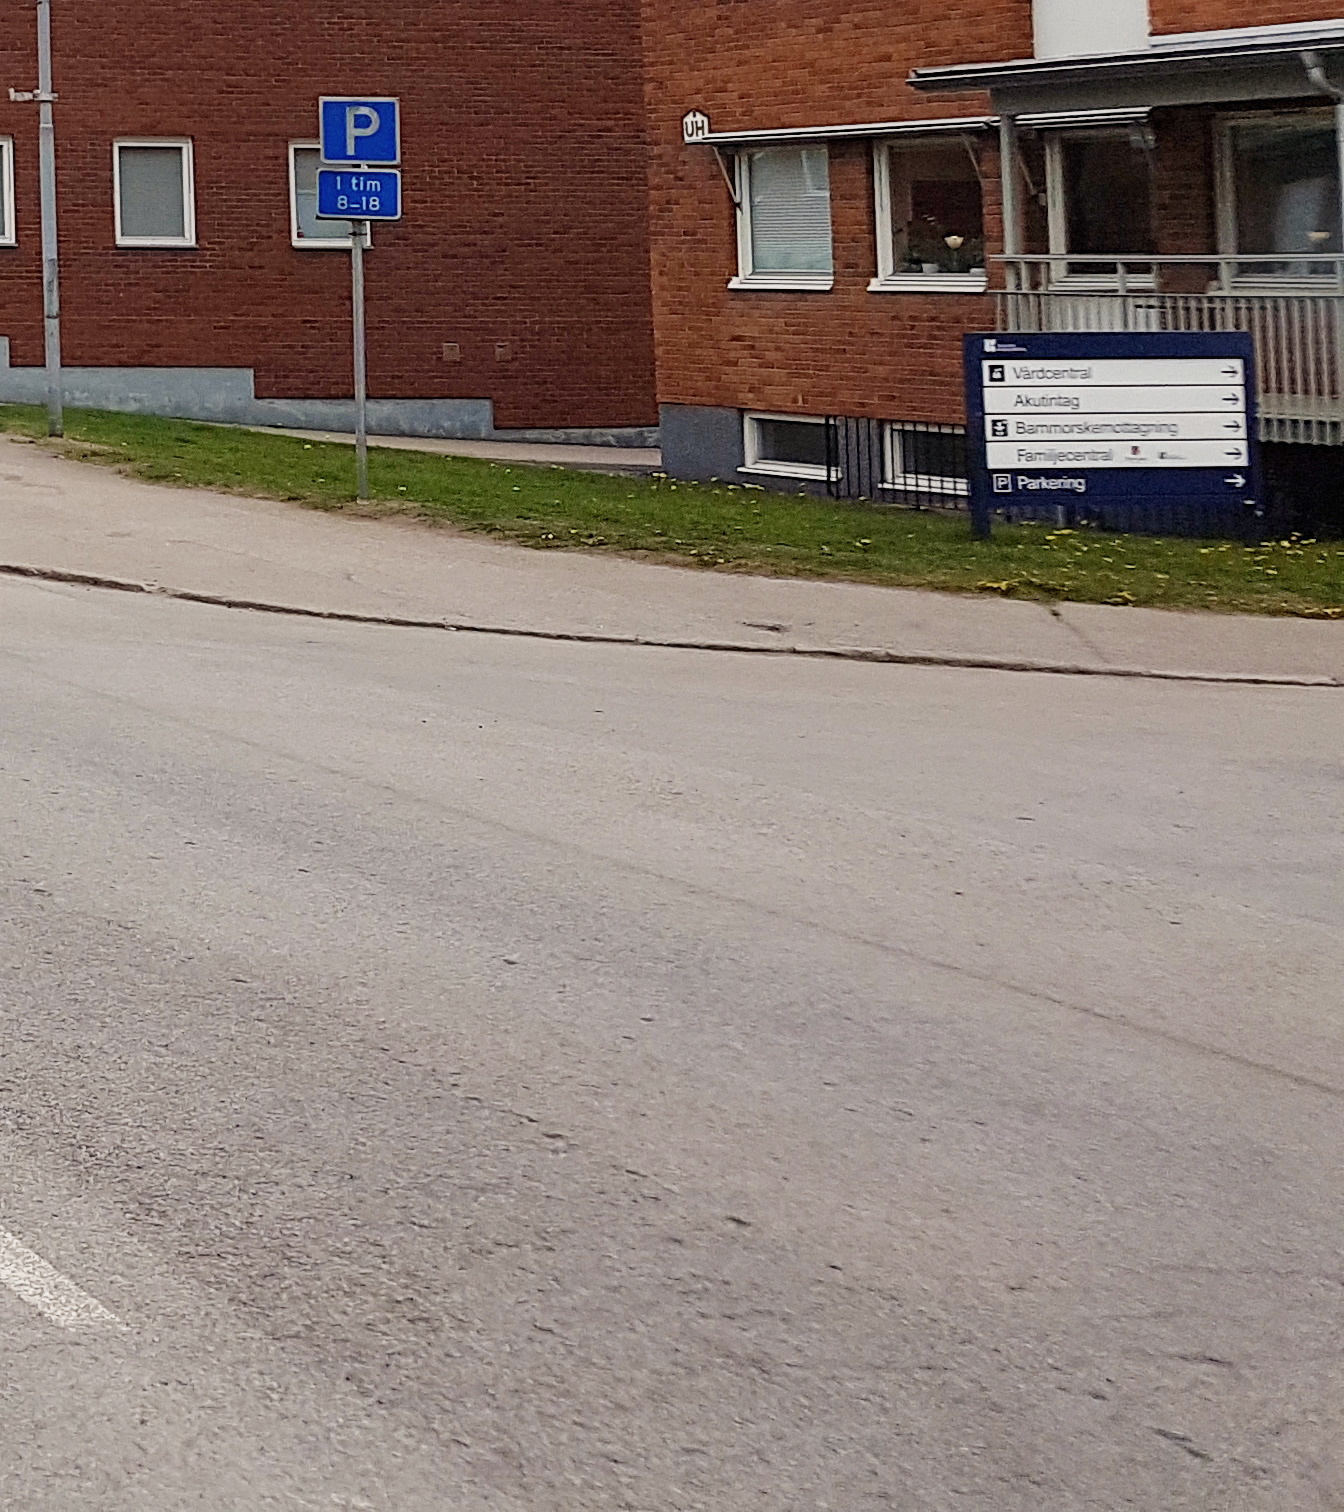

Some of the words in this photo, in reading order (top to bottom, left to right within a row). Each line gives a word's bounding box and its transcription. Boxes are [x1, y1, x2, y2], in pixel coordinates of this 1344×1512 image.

[346, 105, 380, 156] P
[685, 119, 705, 138] UH
[336, 175, 341, 190] 1
[351, 176, 381, 192] tim
[337, 195, 380, 211] 8-18
[1013, 366, 1092, 380] Vårdcentral
[1014, 394, 1080, 410] Akutintag
[1017, 448, 1112, 465] Familjecentral
[1017, 475, 1086, 492] Parkering
